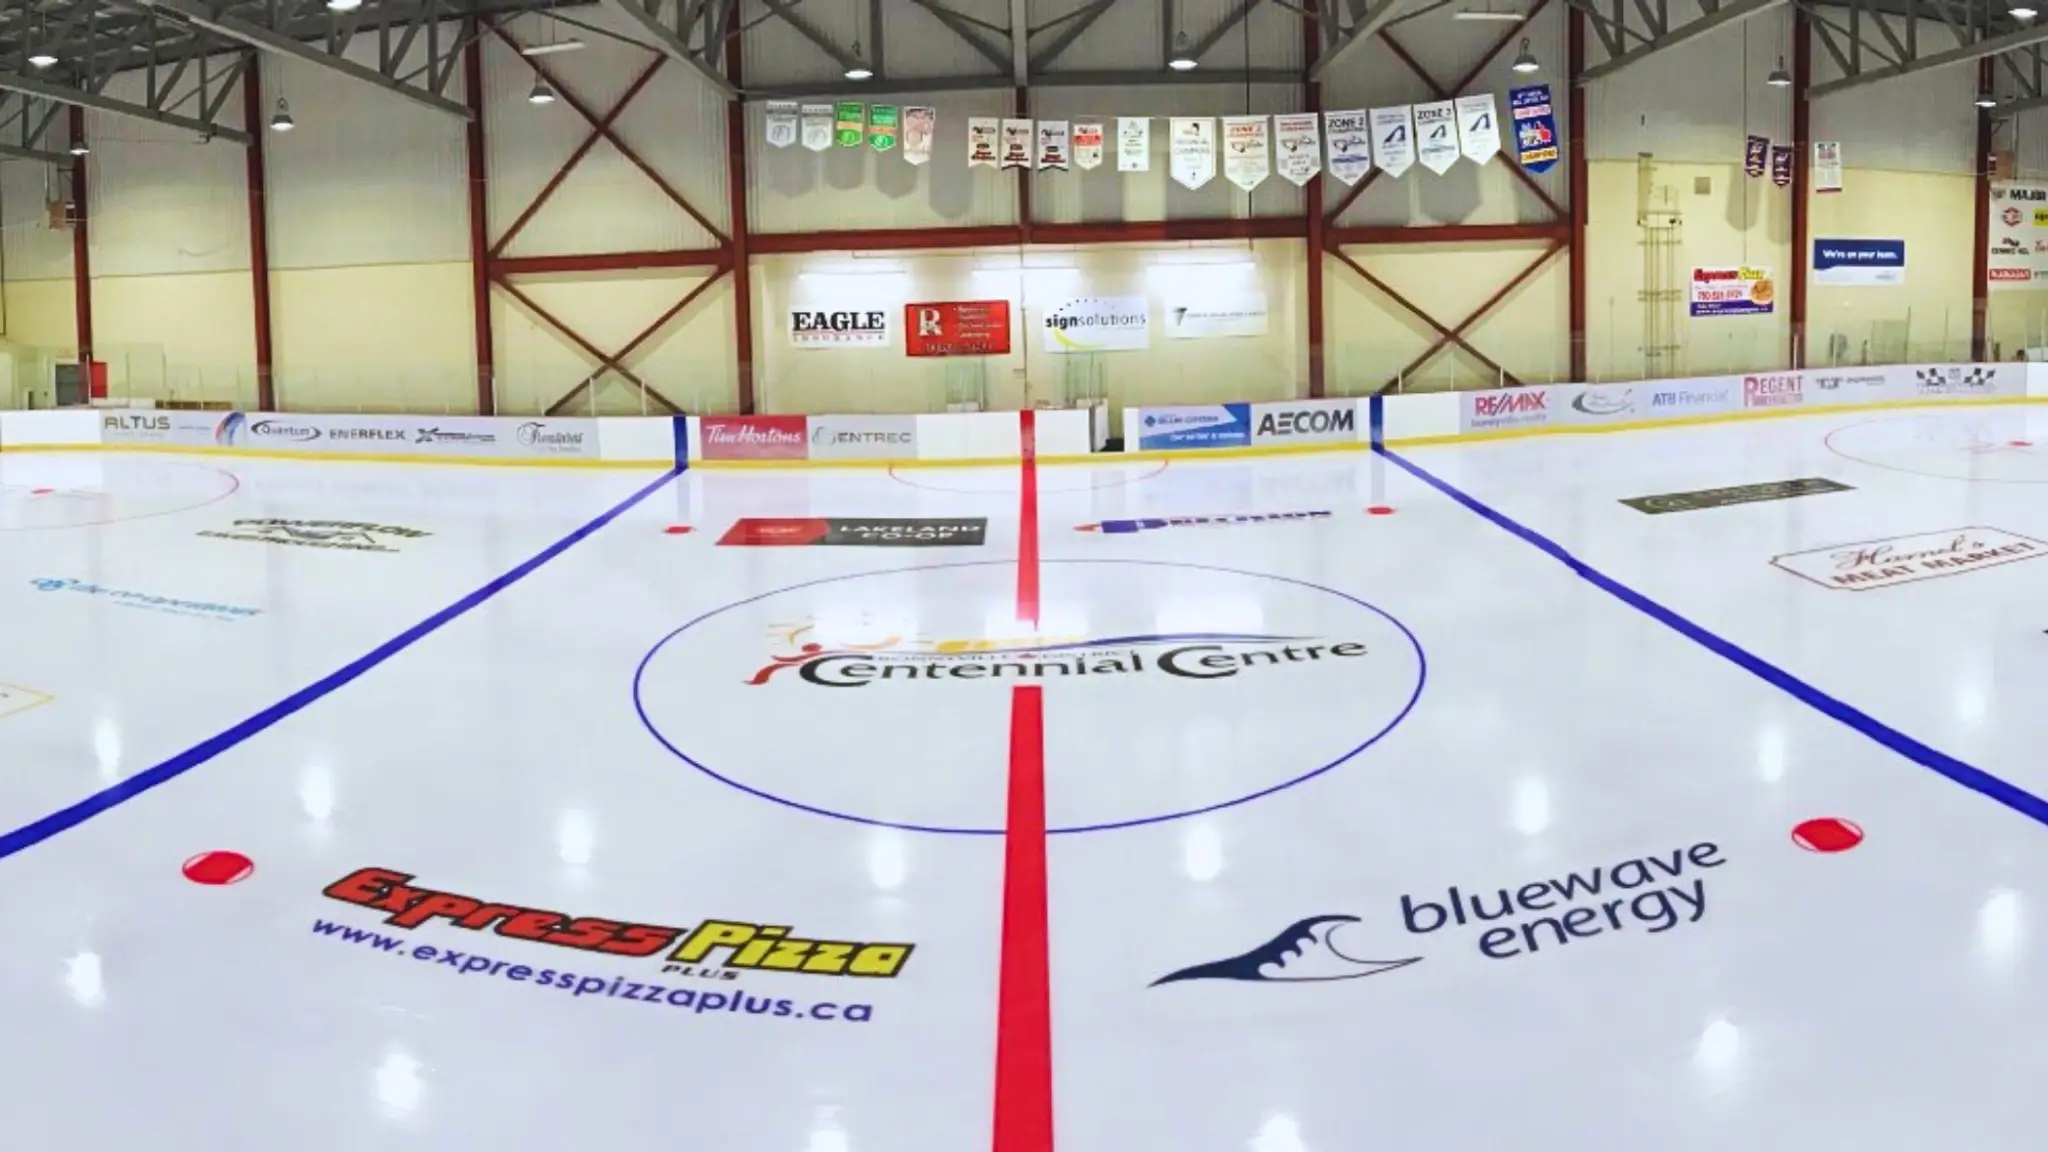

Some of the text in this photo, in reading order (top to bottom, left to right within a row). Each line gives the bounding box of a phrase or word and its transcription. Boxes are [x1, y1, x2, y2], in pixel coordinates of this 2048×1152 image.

[792, 312, 884, 331] EAGLE
[1475, 391, 1546, 416] RE/MAX
[104, 417, 171, 430] ALTUS
[329, 428, 406, 440] ENERFLEX
[706, 424, 801, 446] Tim Hortons
[1257, 409, 1354, 436] AECOM
[1831, 565, 1915, 586] MEAT
[799, 642, 1368, 687] Centennial Centre
[1401, 842, 1726, 933] bluewave
[323, 867, 915, 979] Express Pizza
[1478, 879, 1707, 960] energy
[311, 919, 874, 1023] www.expresspizzaplus.ca
[661, 964, 740, 980] PLUS
